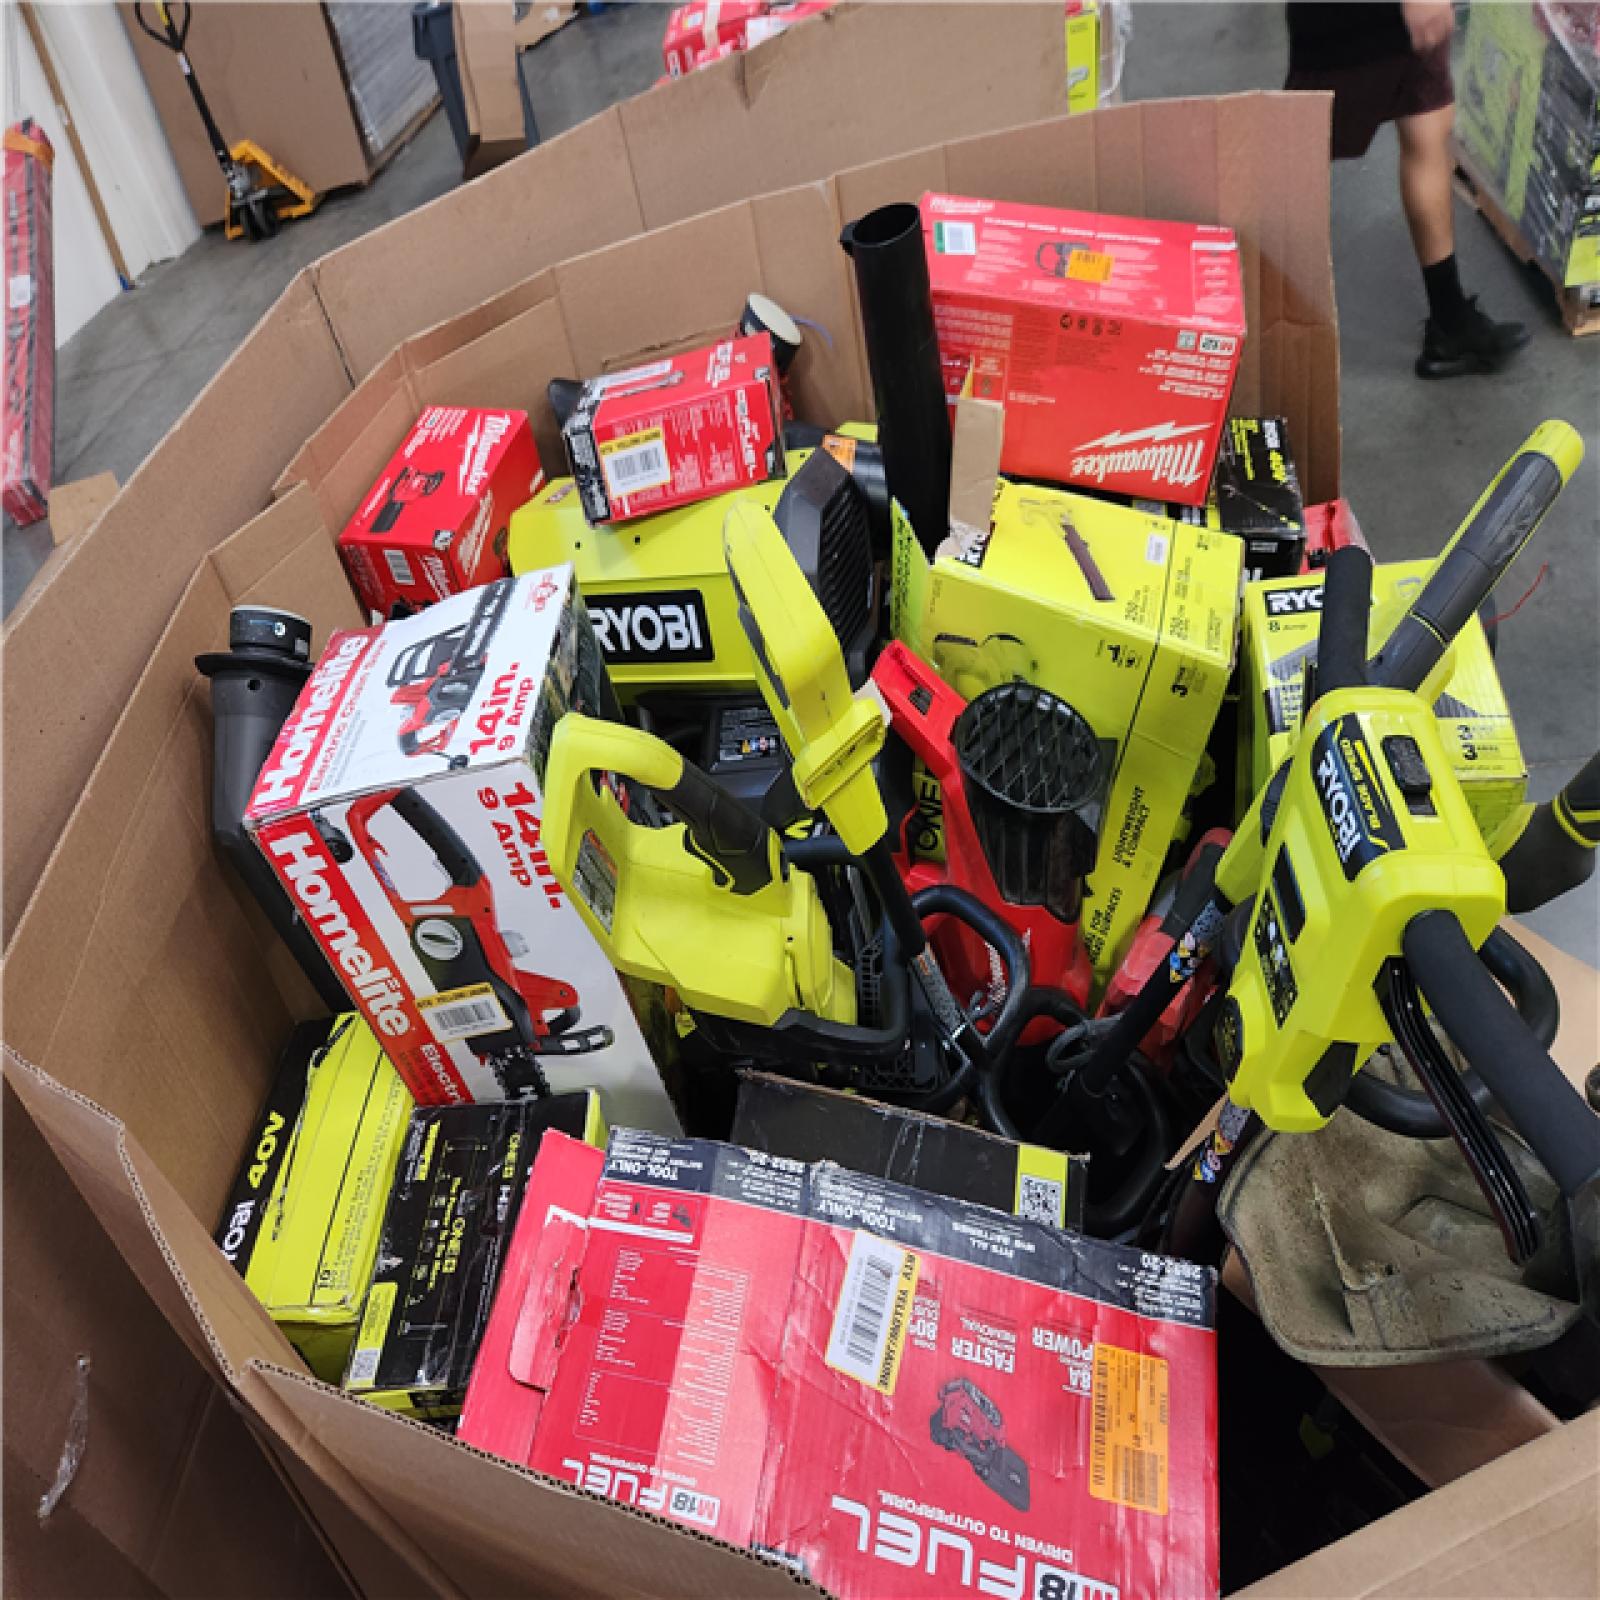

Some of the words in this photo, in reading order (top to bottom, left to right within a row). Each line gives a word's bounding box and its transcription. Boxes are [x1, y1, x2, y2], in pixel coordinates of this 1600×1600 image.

[1070, 440, 1203, 486] Milwaukee
[588, 605, 702, 653] RYOBI
[253, 636, 368, 808] Homelite
[471, 662, 519, 755] 14in.
[506, 677, 535, 725] Amp
[1318, 750, 1361, 863] RYOBI
[494, 822, 531, 888] Amp
[265, 833, 410, 1037] Homelite
[247, 1112, 286, 1188] 40V
[952, 1337, 1016, 1374] FASTER
[1033, 1326, 1093, 1360] POWER
[562, 1459, 666, 1509] FUEL
[831, 1494, 1026, 1600] FUEL
[989, 1526, 1010, 1543] TO
[1015, 1533, 1074, 1564] DRIVEN
